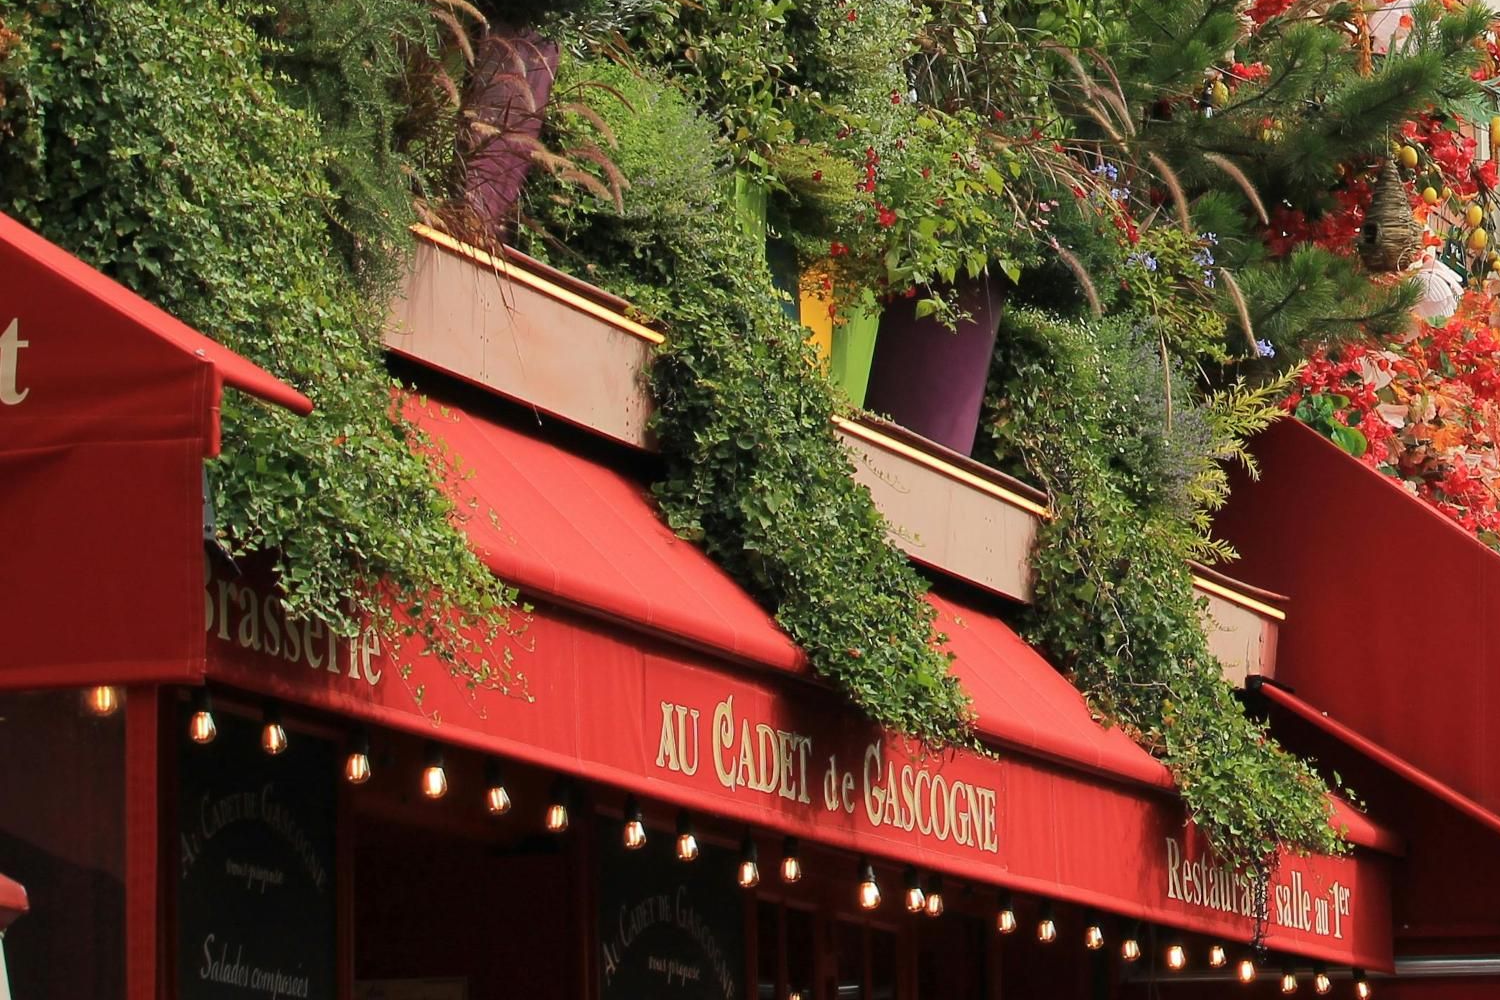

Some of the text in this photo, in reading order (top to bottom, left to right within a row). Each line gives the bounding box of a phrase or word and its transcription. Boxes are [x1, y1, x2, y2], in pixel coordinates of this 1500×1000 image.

[656, 694, 998, 854] AU CADET de GASCOGNE
[1275, 870, 1312, 932] salle
[1315, 897, 1330, 936] au
[1332, 881, 1350, 939] 1er
[200, 932, 249, 988] Salades
